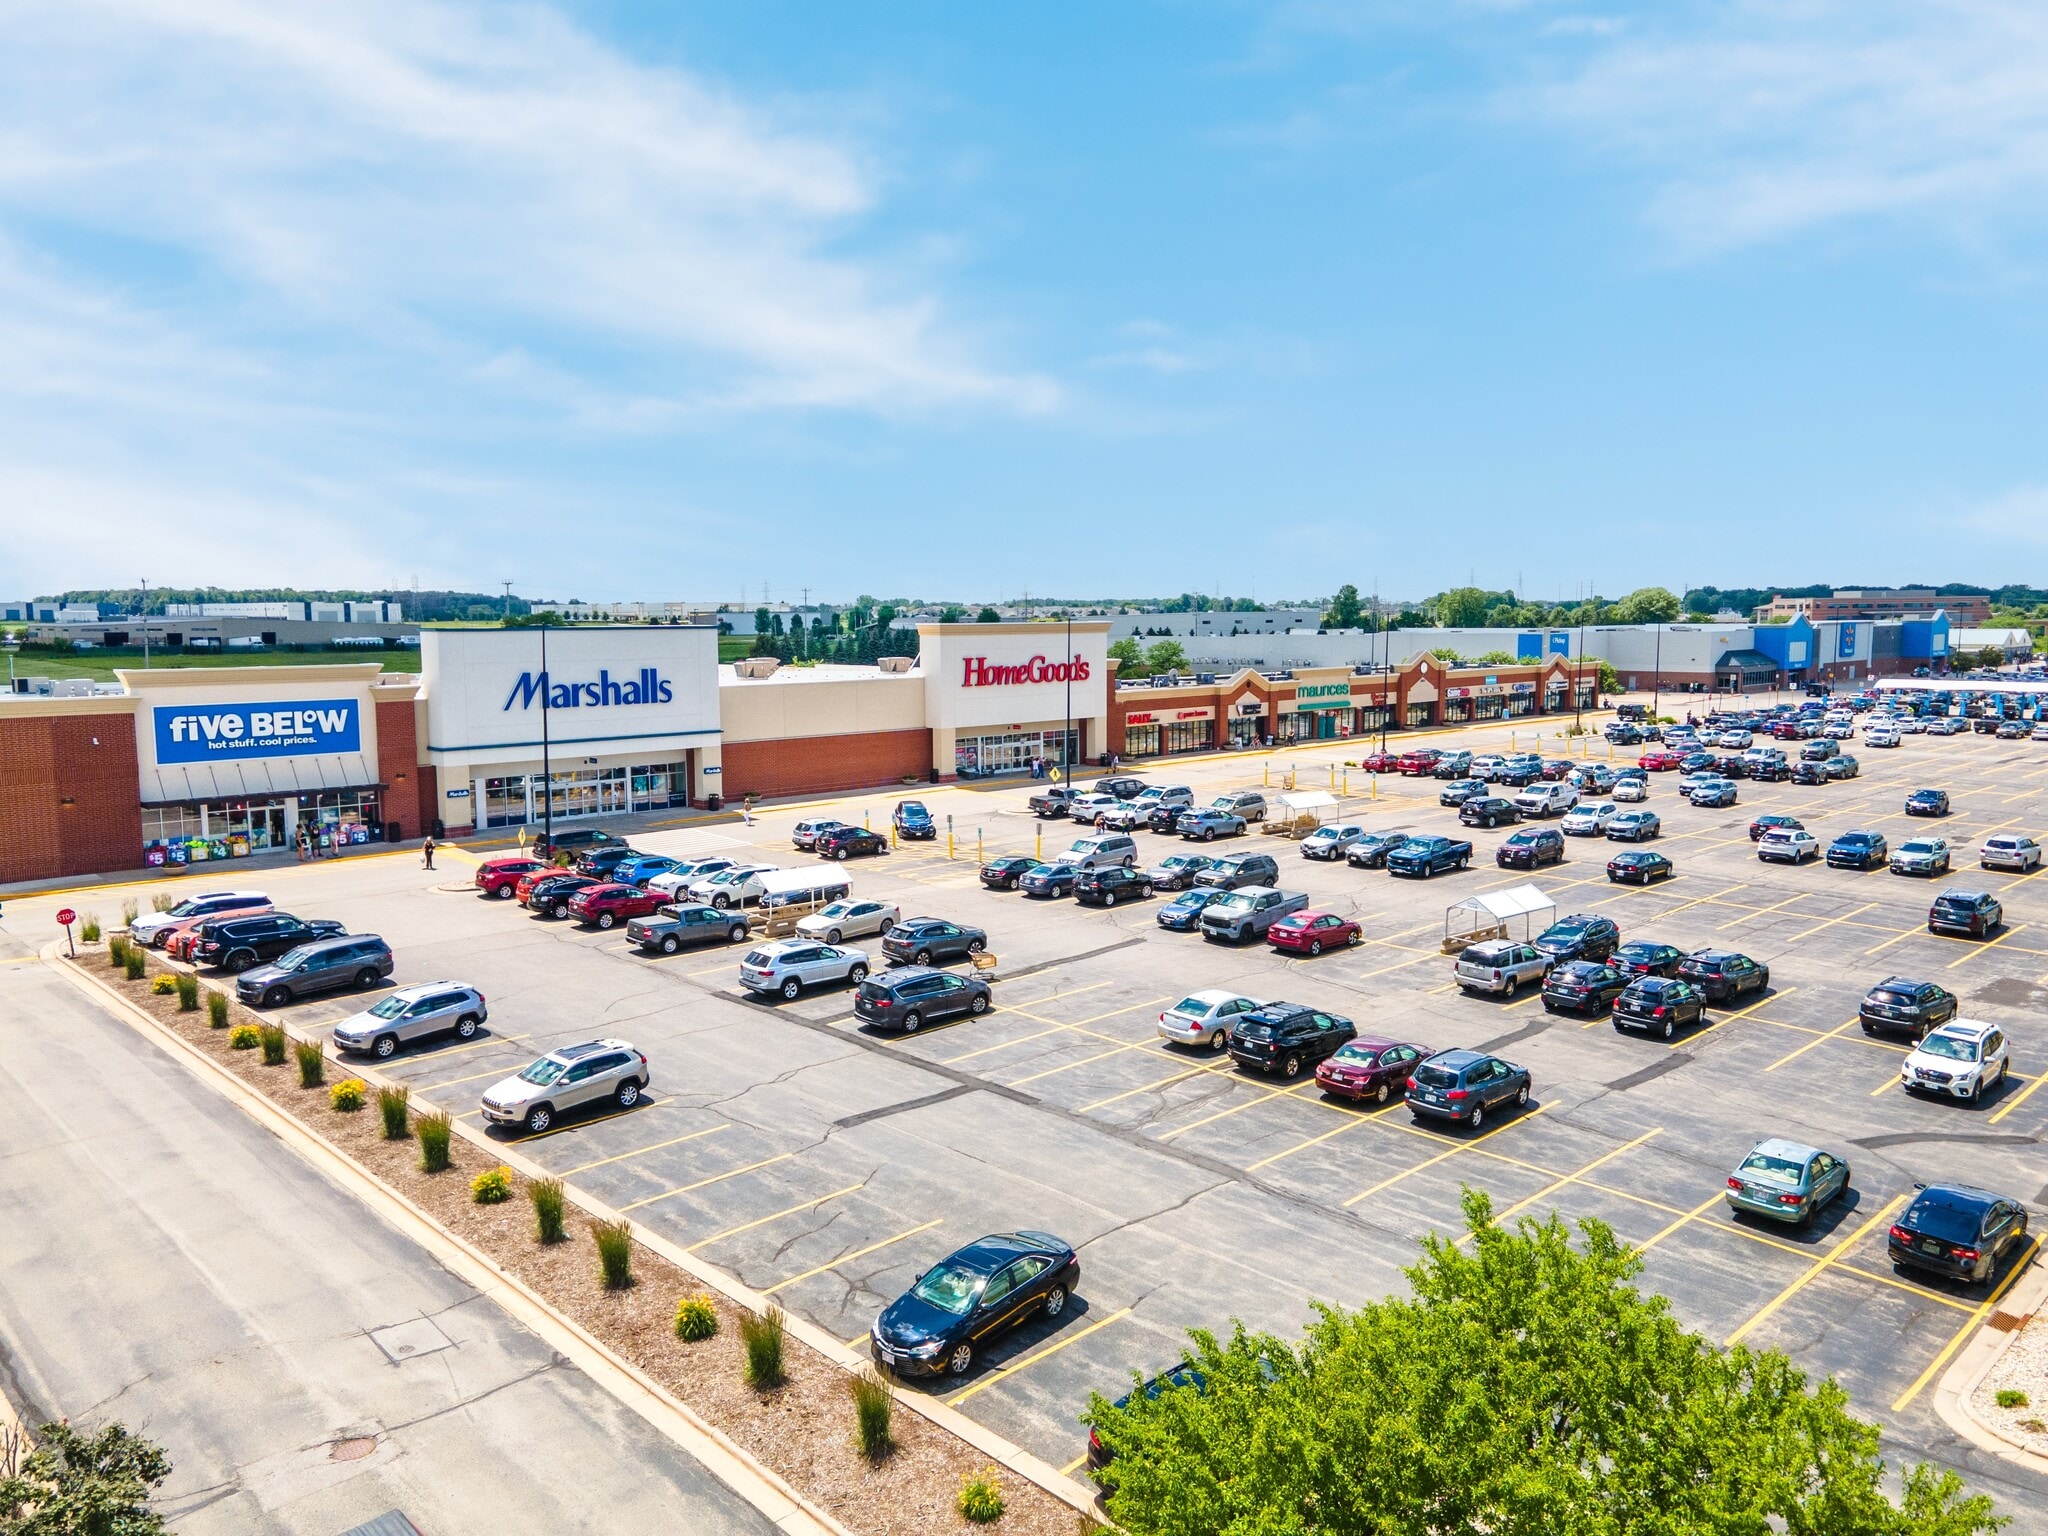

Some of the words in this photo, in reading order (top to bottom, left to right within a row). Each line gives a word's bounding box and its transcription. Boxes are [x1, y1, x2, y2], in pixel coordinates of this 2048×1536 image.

[961, 653, 1090, 687] HomeGoods
[503, 668, 673, 711] Marshalls
[1297, 683, 1349, 698] maurices
[1127, 713, 1152, 724] SALLY
[169, 713, 244, 742] five
[208, 740, 227, 750] hot
[228, 738, 258, 749] stuff.
[259, 737, 281, 747] cool
[283, 735, 317, 747] prices.
[149, 853, 164, 865] $5
[171, 851, 186, 862] $5
[57, 912, 75, 922] STOP
